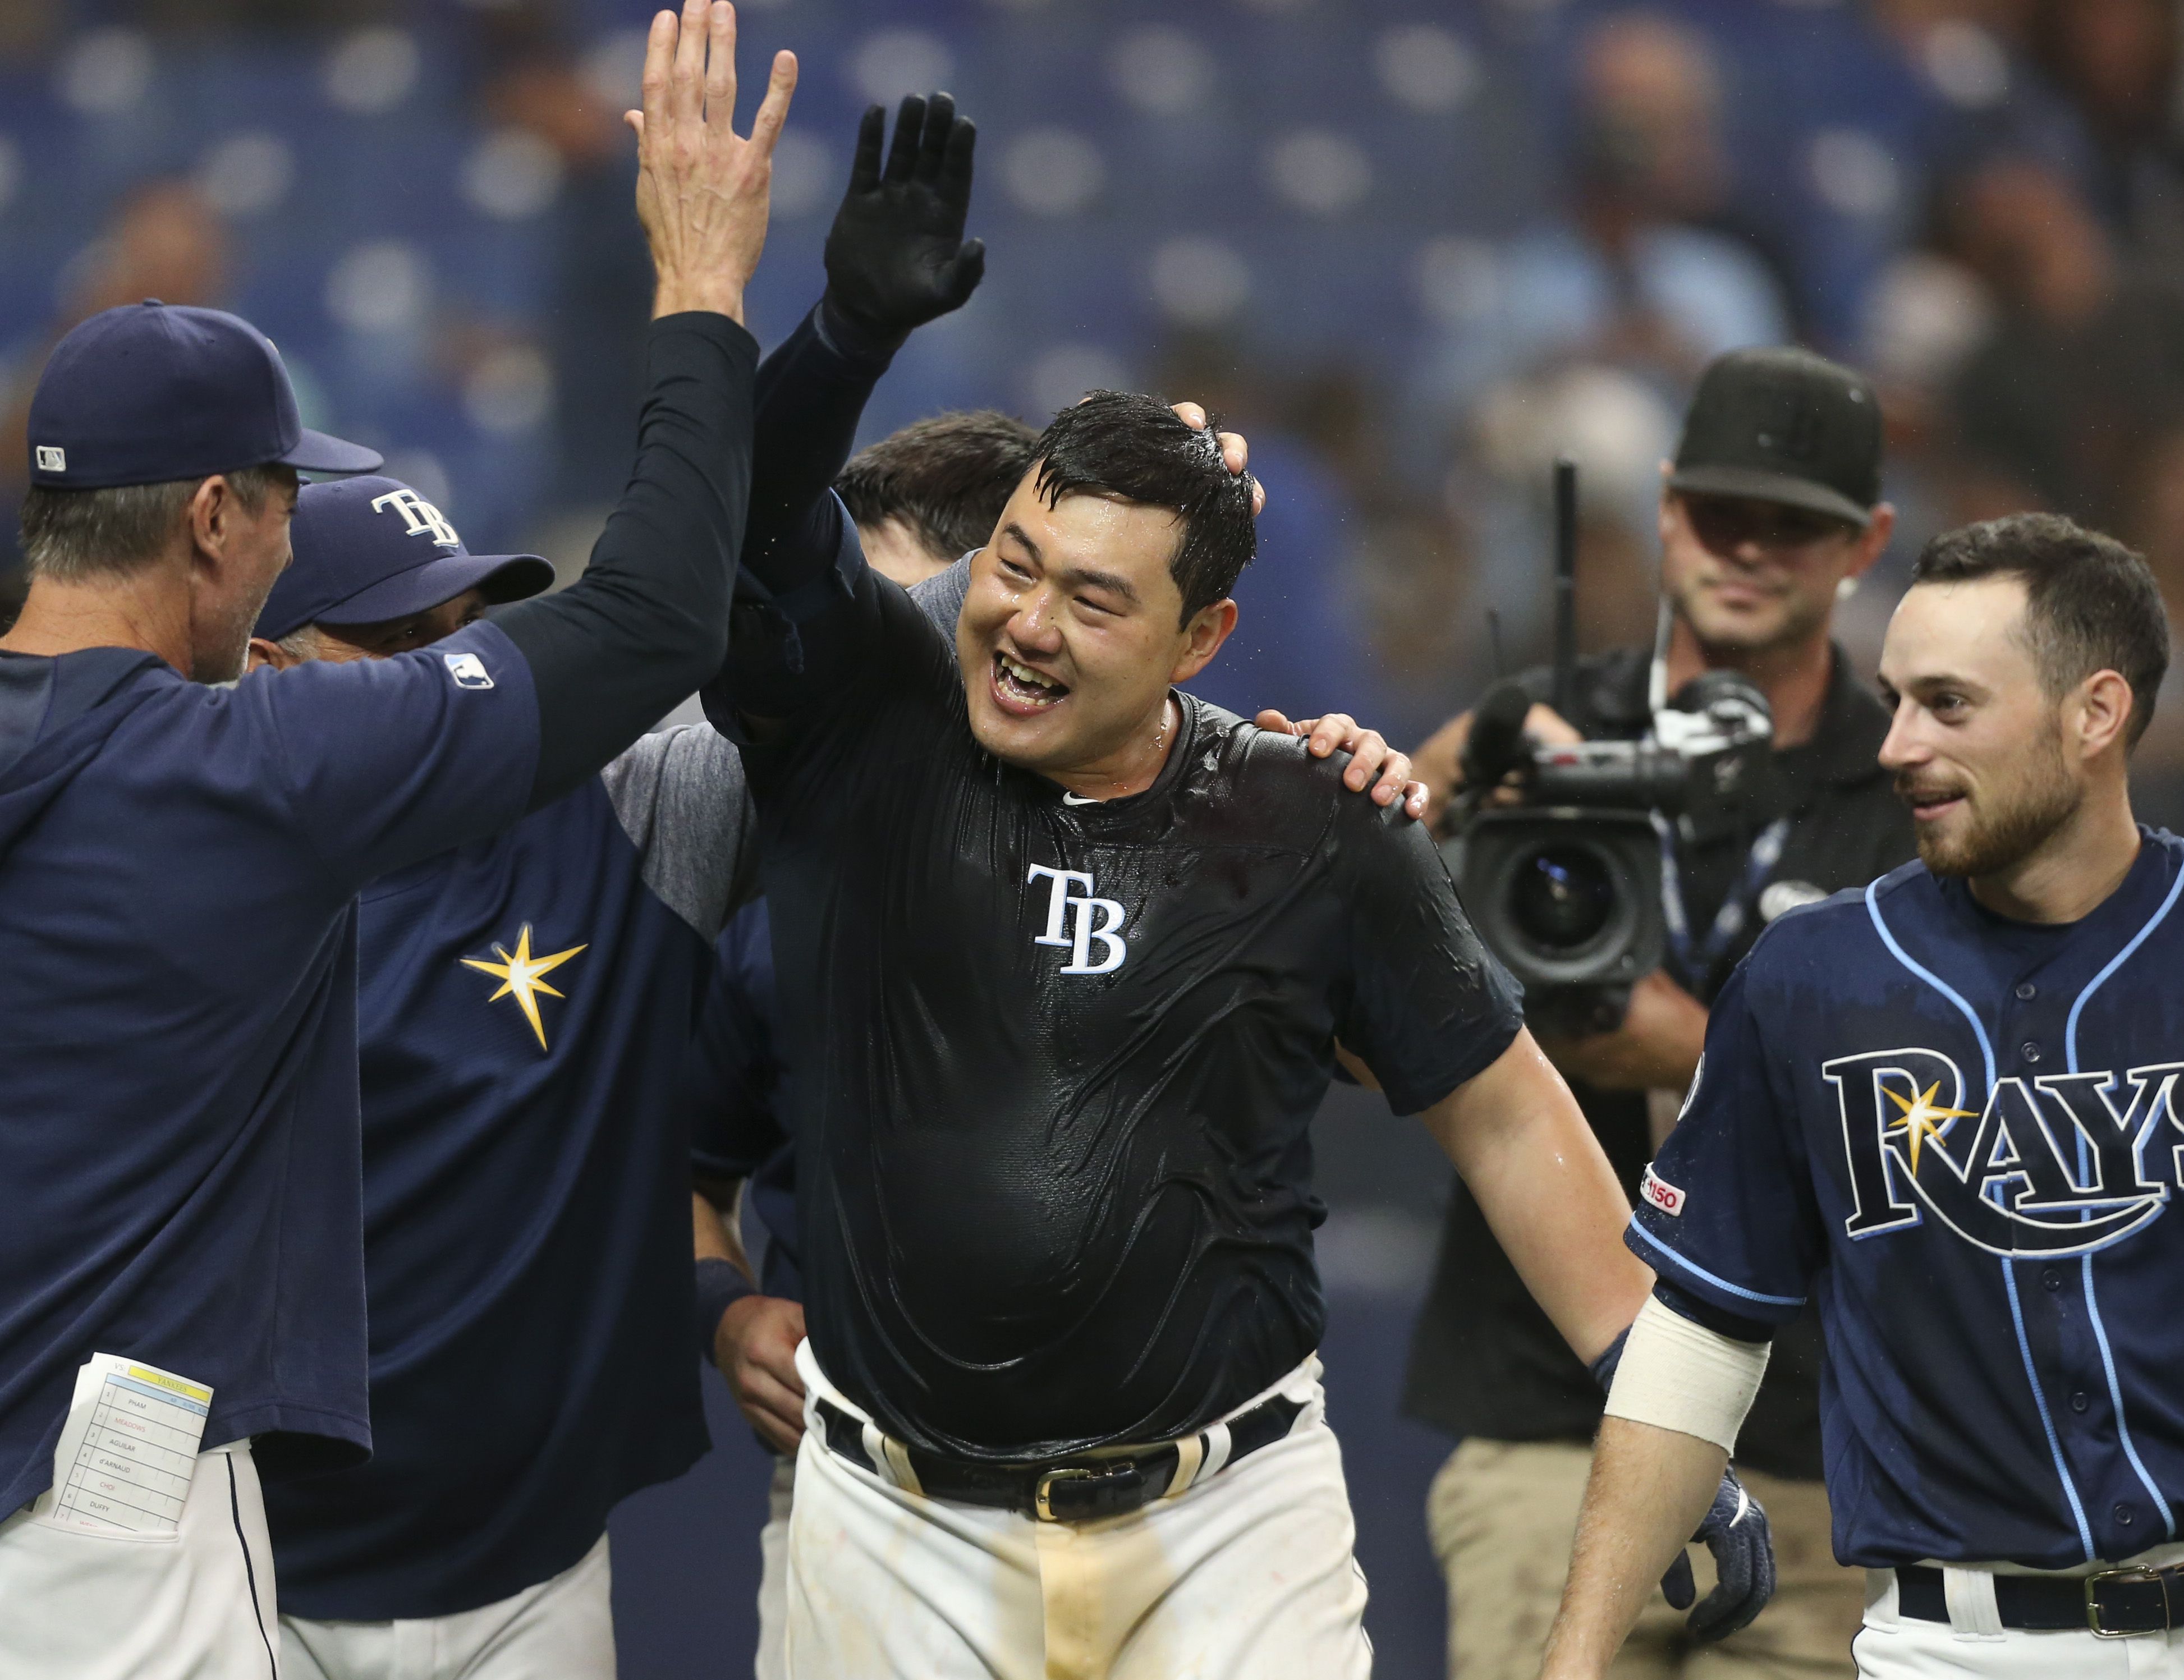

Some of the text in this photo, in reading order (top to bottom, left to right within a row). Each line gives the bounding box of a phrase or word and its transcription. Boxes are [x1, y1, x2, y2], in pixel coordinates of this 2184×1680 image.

[371, 489, 460, 548] TB
[1027, 862, 1127, 975] TB
[1821, 1046, 2184, 1260] RAY
[158, 1377, 187, 1392] YANKEES
[128, 1399, 146, 1409] PHAM
[115, 1417, 146, 1432] MEADOWS
[109, 1439, 136, 1452] AGUILAR
[100, 1481, 116, 1490] CHOI
[90, 1501, 109, 1512] DUFFY
